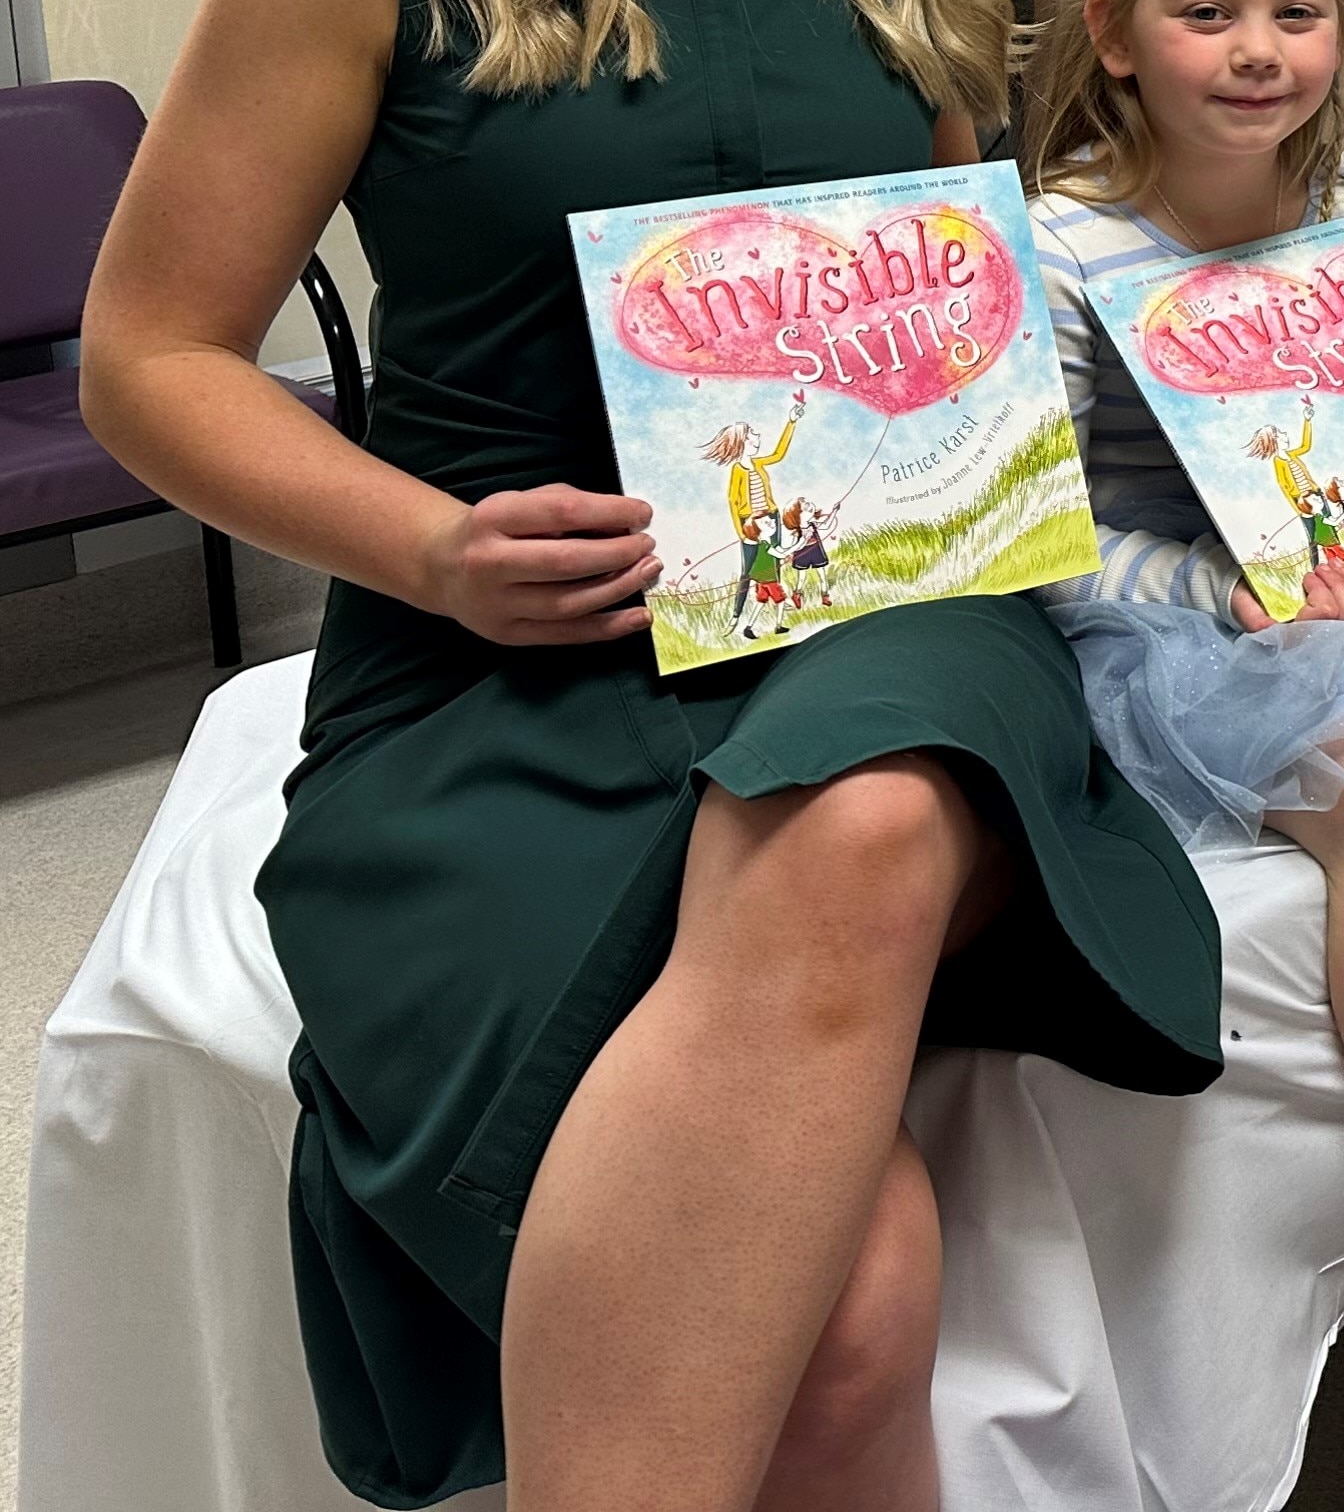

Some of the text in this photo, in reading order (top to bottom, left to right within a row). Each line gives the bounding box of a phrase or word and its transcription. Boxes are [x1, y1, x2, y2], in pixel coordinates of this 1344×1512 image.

[634, 177, 968, 225] THE BESTSELLING PHENOMENON THAT HAS INSPIRED READERS AROUND THE WORLD
[647, 218, 976, 354] Invisible
[664, 246, 726, 284] The
[1165, 292, 1215, 328] The
[774, 292, 983, 388] String
[881, 414, 980, 484] Patrice Karst
[886, 489, 930, 505] Illustrated
[931, 484, 941, 496] by
[941, 463, 973, 489] Joanne
